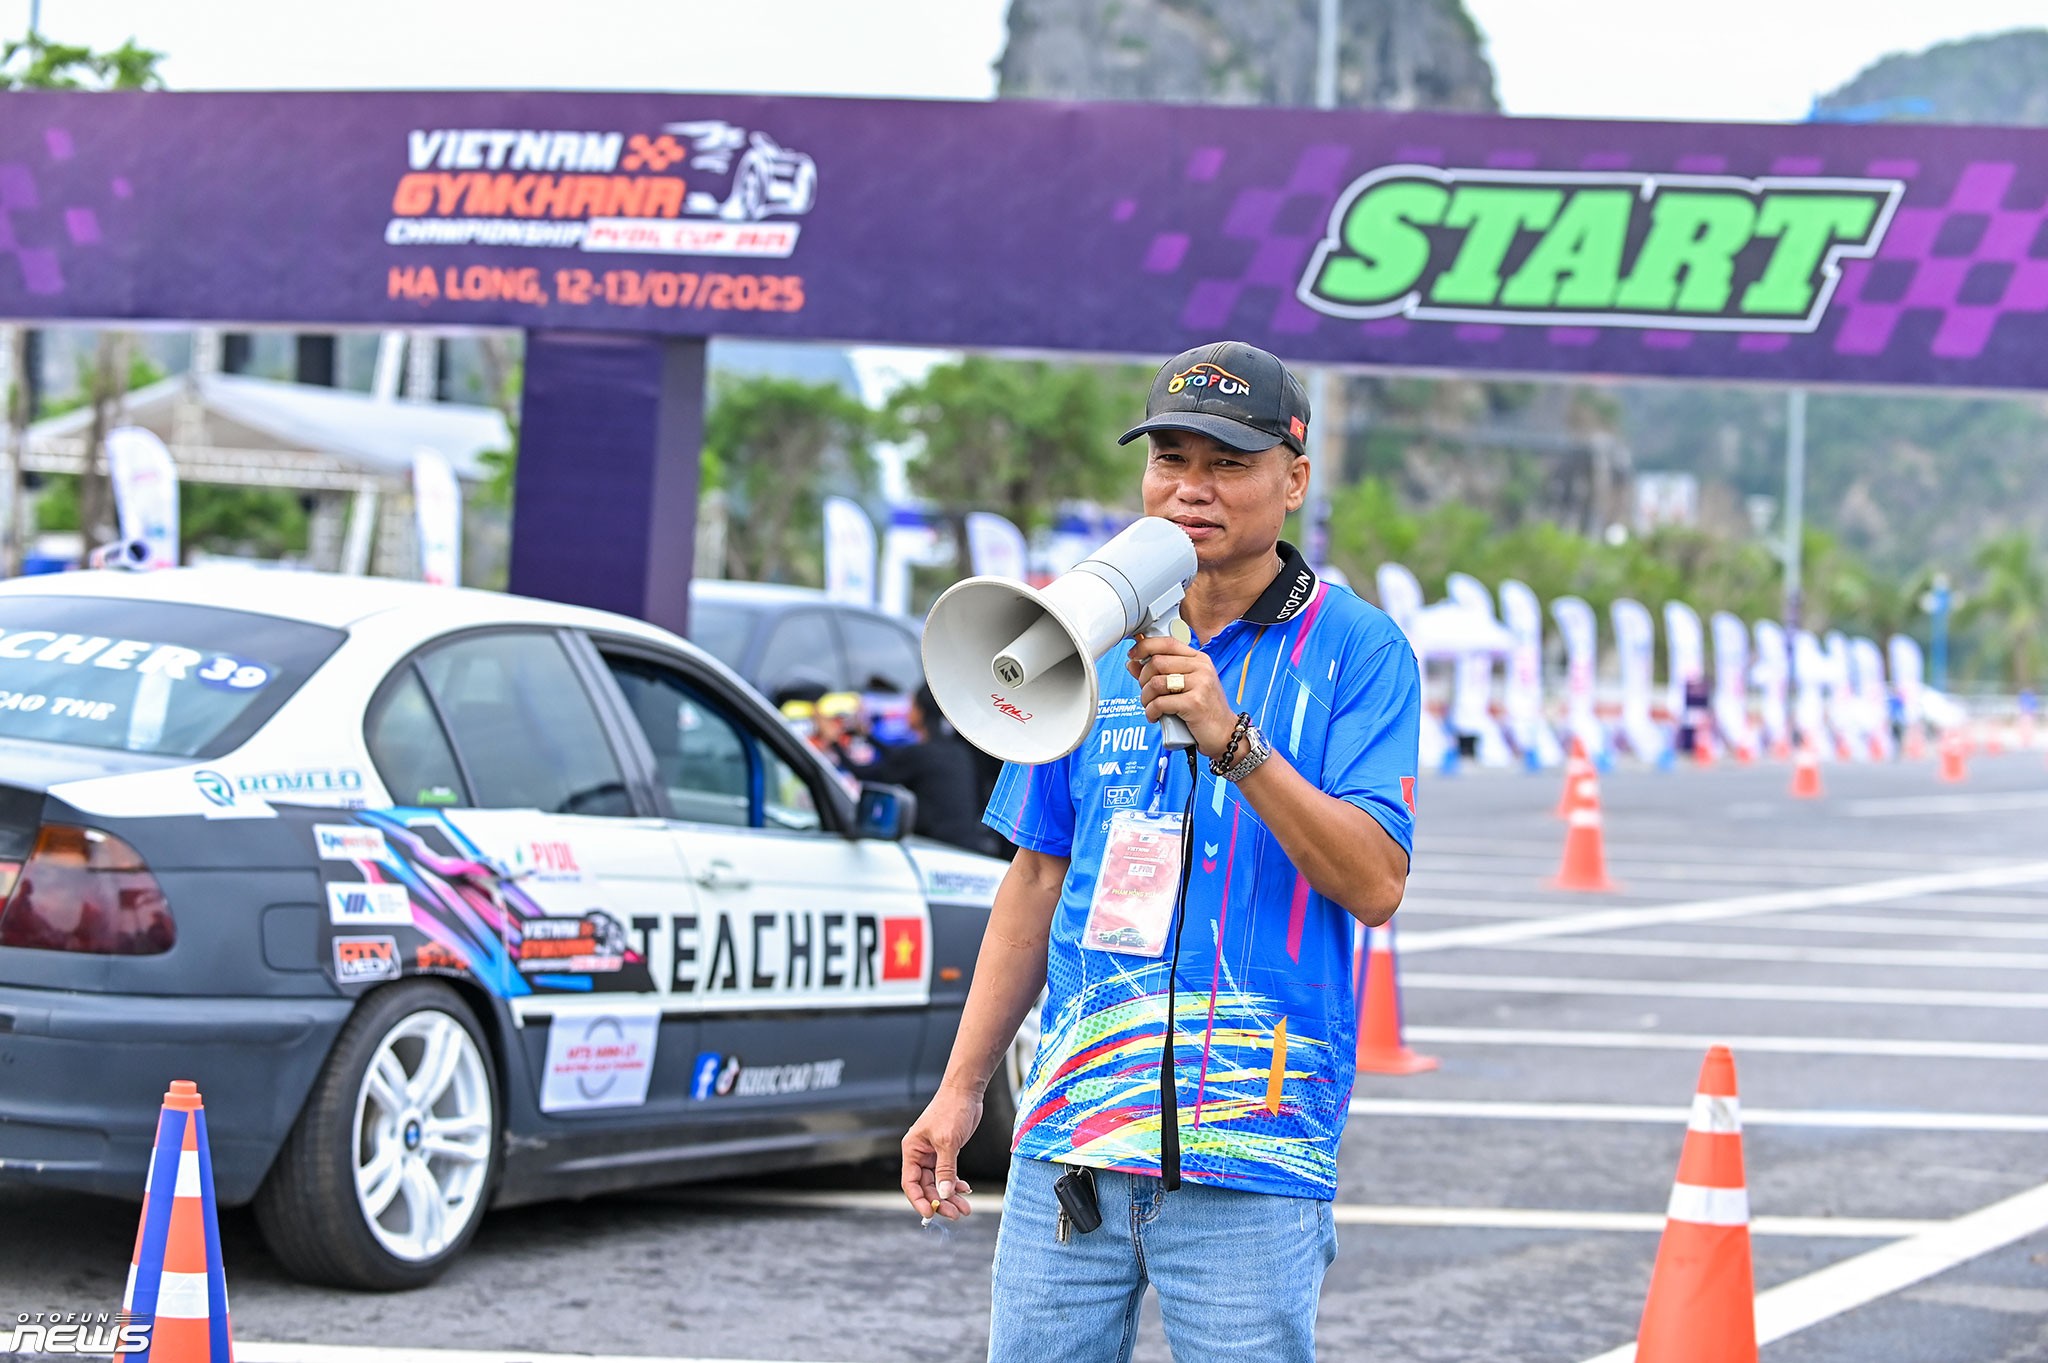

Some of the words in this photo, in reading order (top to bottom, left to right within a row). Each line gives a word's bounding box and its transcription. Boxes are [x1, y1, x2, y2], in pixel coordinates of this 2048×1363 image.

[408, 130, 623, 172] VIETNAM
[393, 173, 686, 219] GYMKHANA
[1321, 182, 1877, 313] START
[446, 266, 549, 307] LONG,
[556, 268, 805, 312] 12-13/07/2025
[1167, 373, 1251, 397] OTOFUN
[1276, 569, 1311, 620] OTOFUN
[0, 628, 202, 681] CHER
[199, 656, 268, 689] 39
[1097, 704, 1137, 715] YMKHANA
[1099, 726, 1149, 754] PVOIL
[1106, 797, 1136, 806] MEDIA
[1107, 788, 1139, 799] OTV
[631, 913, 878, 993] TEACHER
